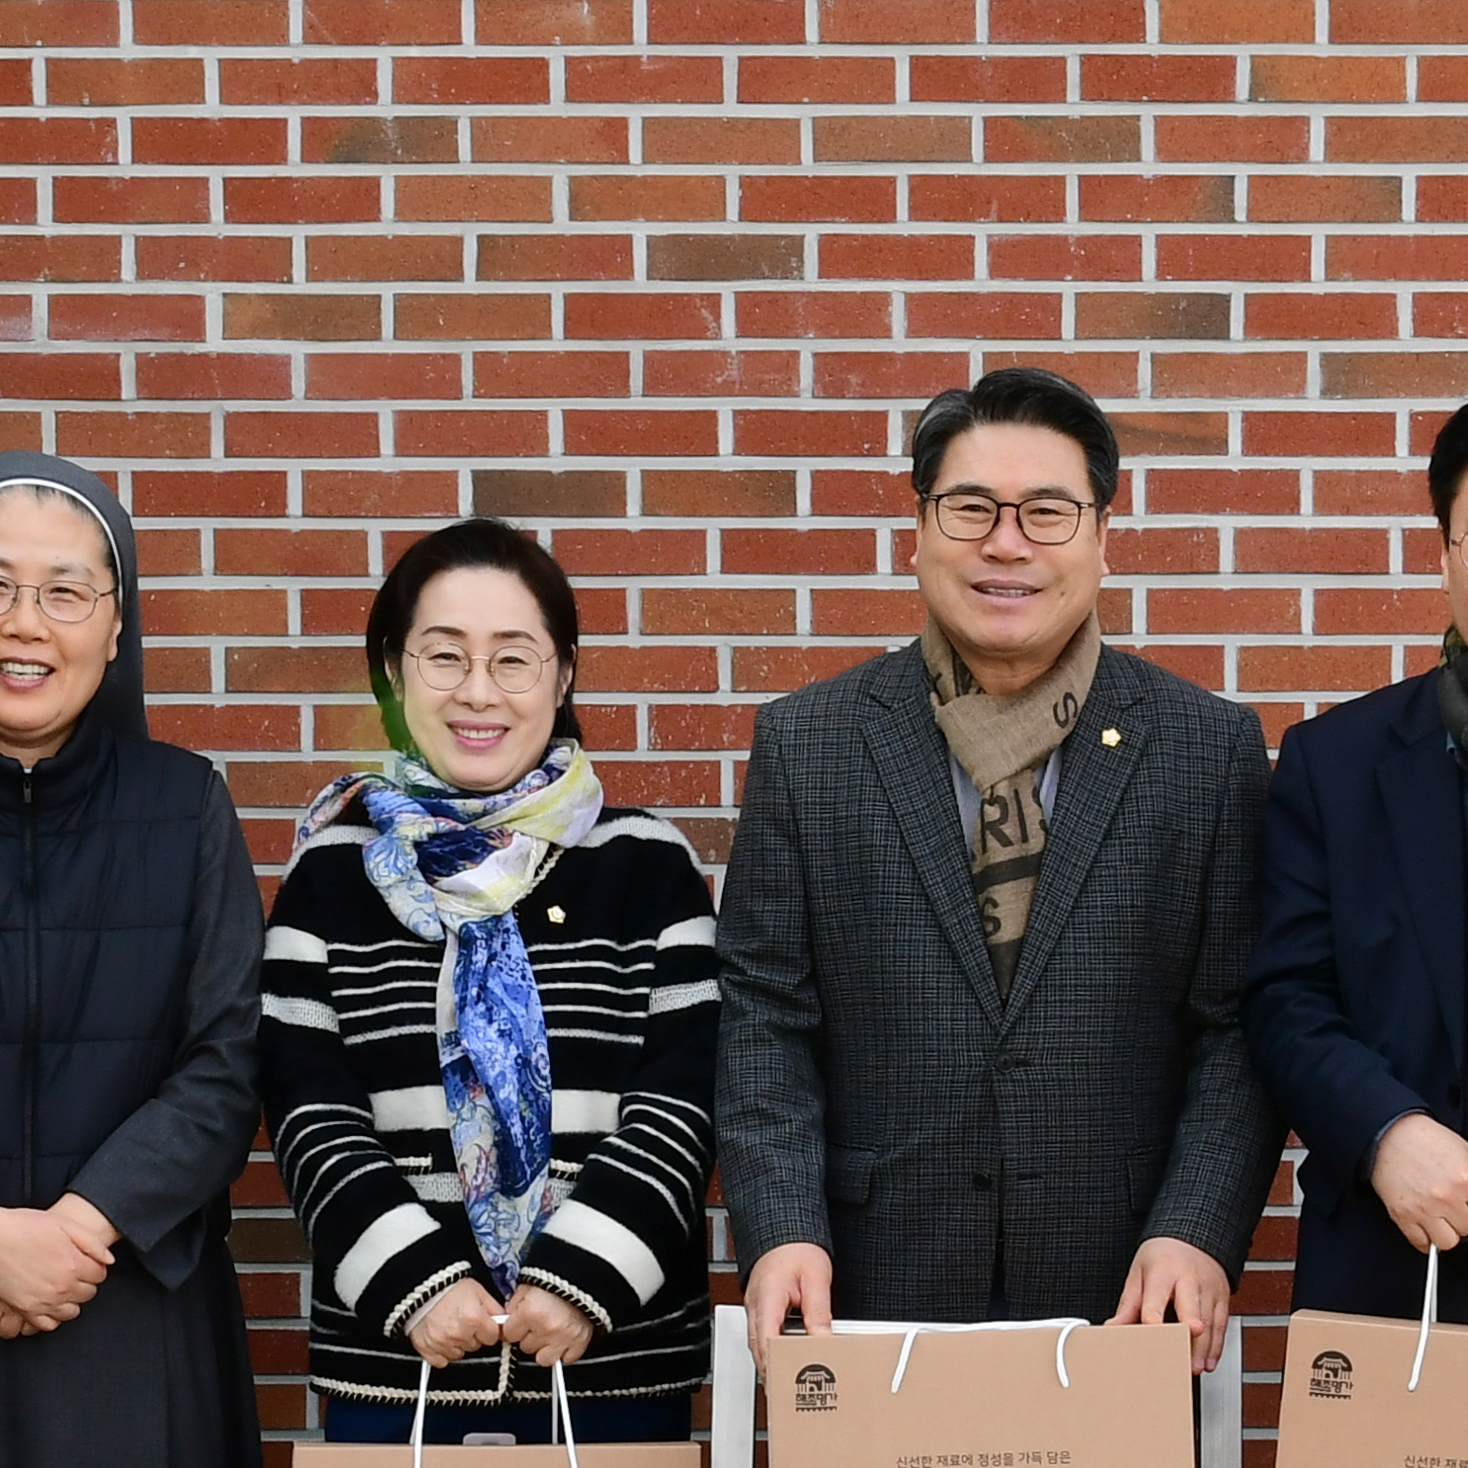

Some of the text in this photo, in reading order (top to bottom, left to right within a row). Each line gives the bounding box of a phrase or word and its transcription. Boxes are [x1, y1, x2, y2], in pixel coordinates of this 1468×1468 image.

[936, 1454, 974, 1467] 재료에
[977, 1452, 1015, 1468] 정성을
[1018, 1451, 1043, 1465] 가득
[1046, 1450, 1072, 1465] 담은
